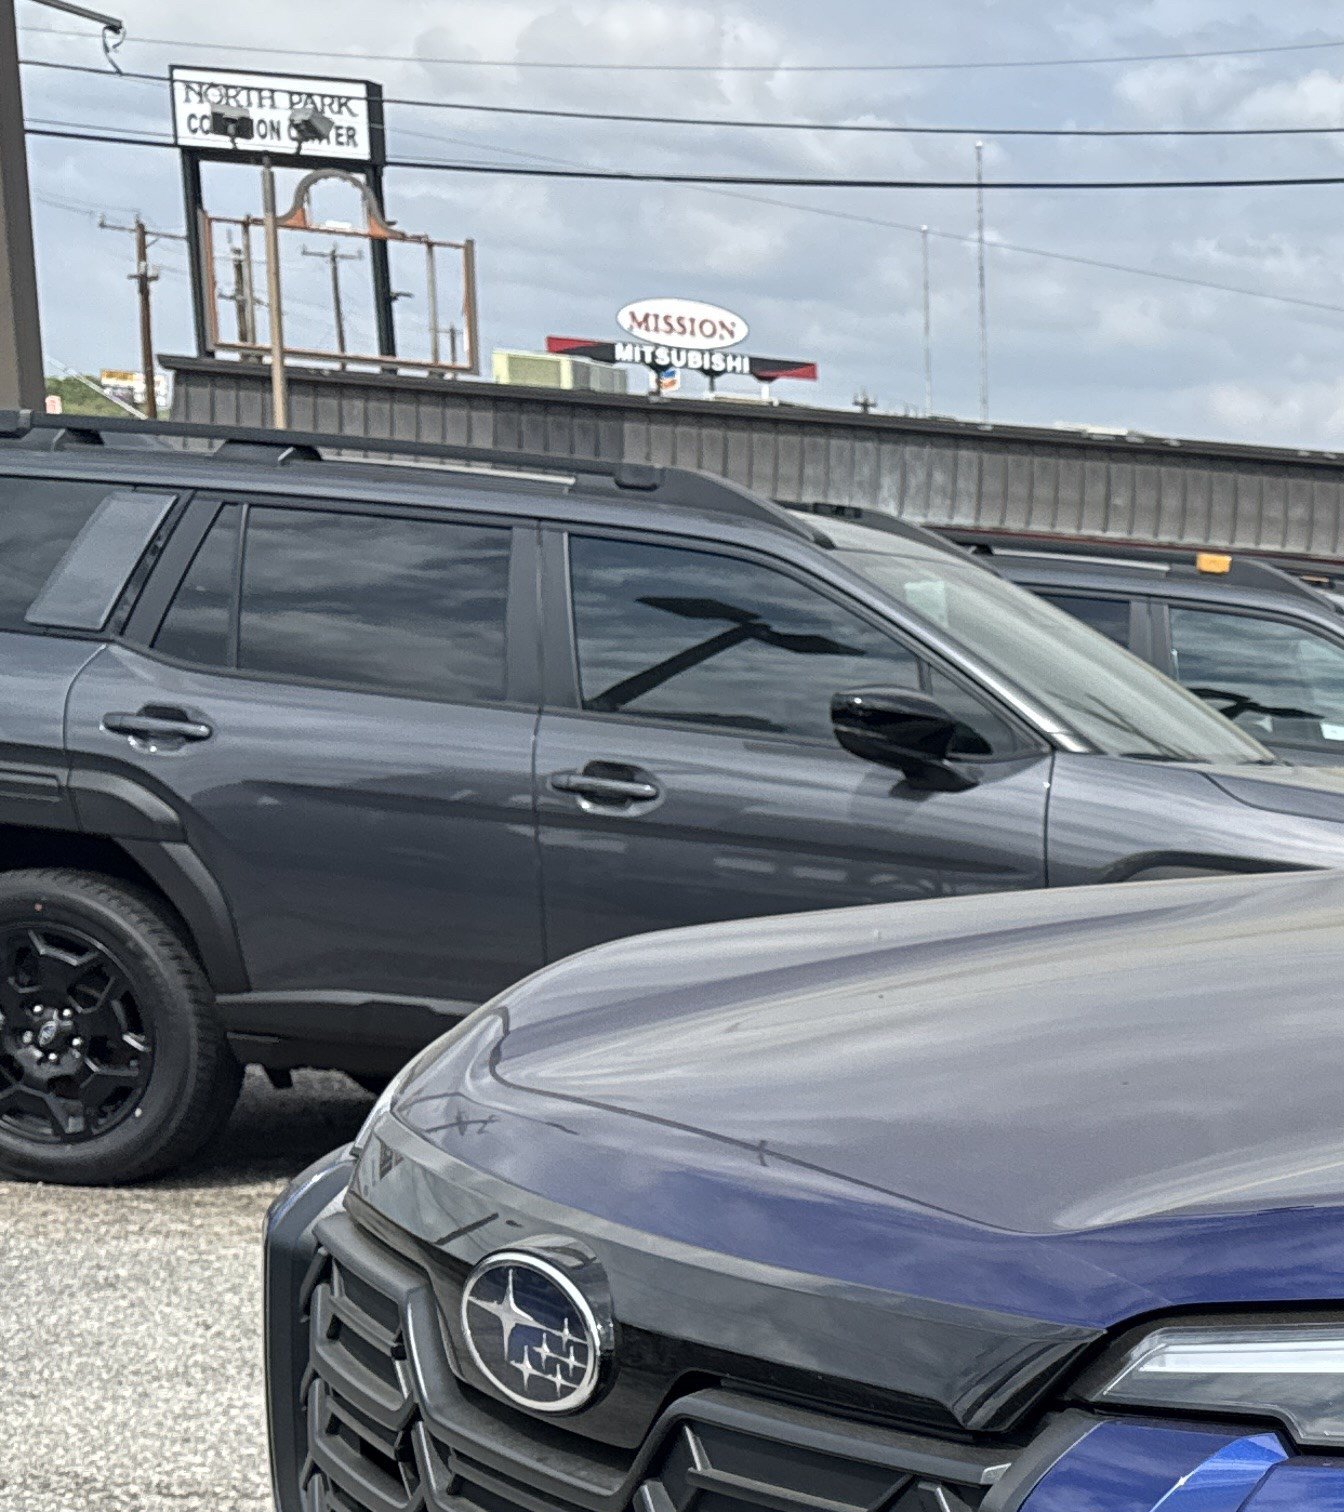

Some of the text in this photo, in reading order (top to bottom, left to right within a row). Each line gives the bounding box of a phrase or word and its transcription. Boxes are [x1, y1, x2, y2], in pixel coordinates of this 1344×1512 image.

[183, 82, 359, 117] NORTH PARK
[287, 121, 358, 148] CER
[629, 311, 736, 340] MISSION
[614, 343, 750, 374] MITSUBISHI
